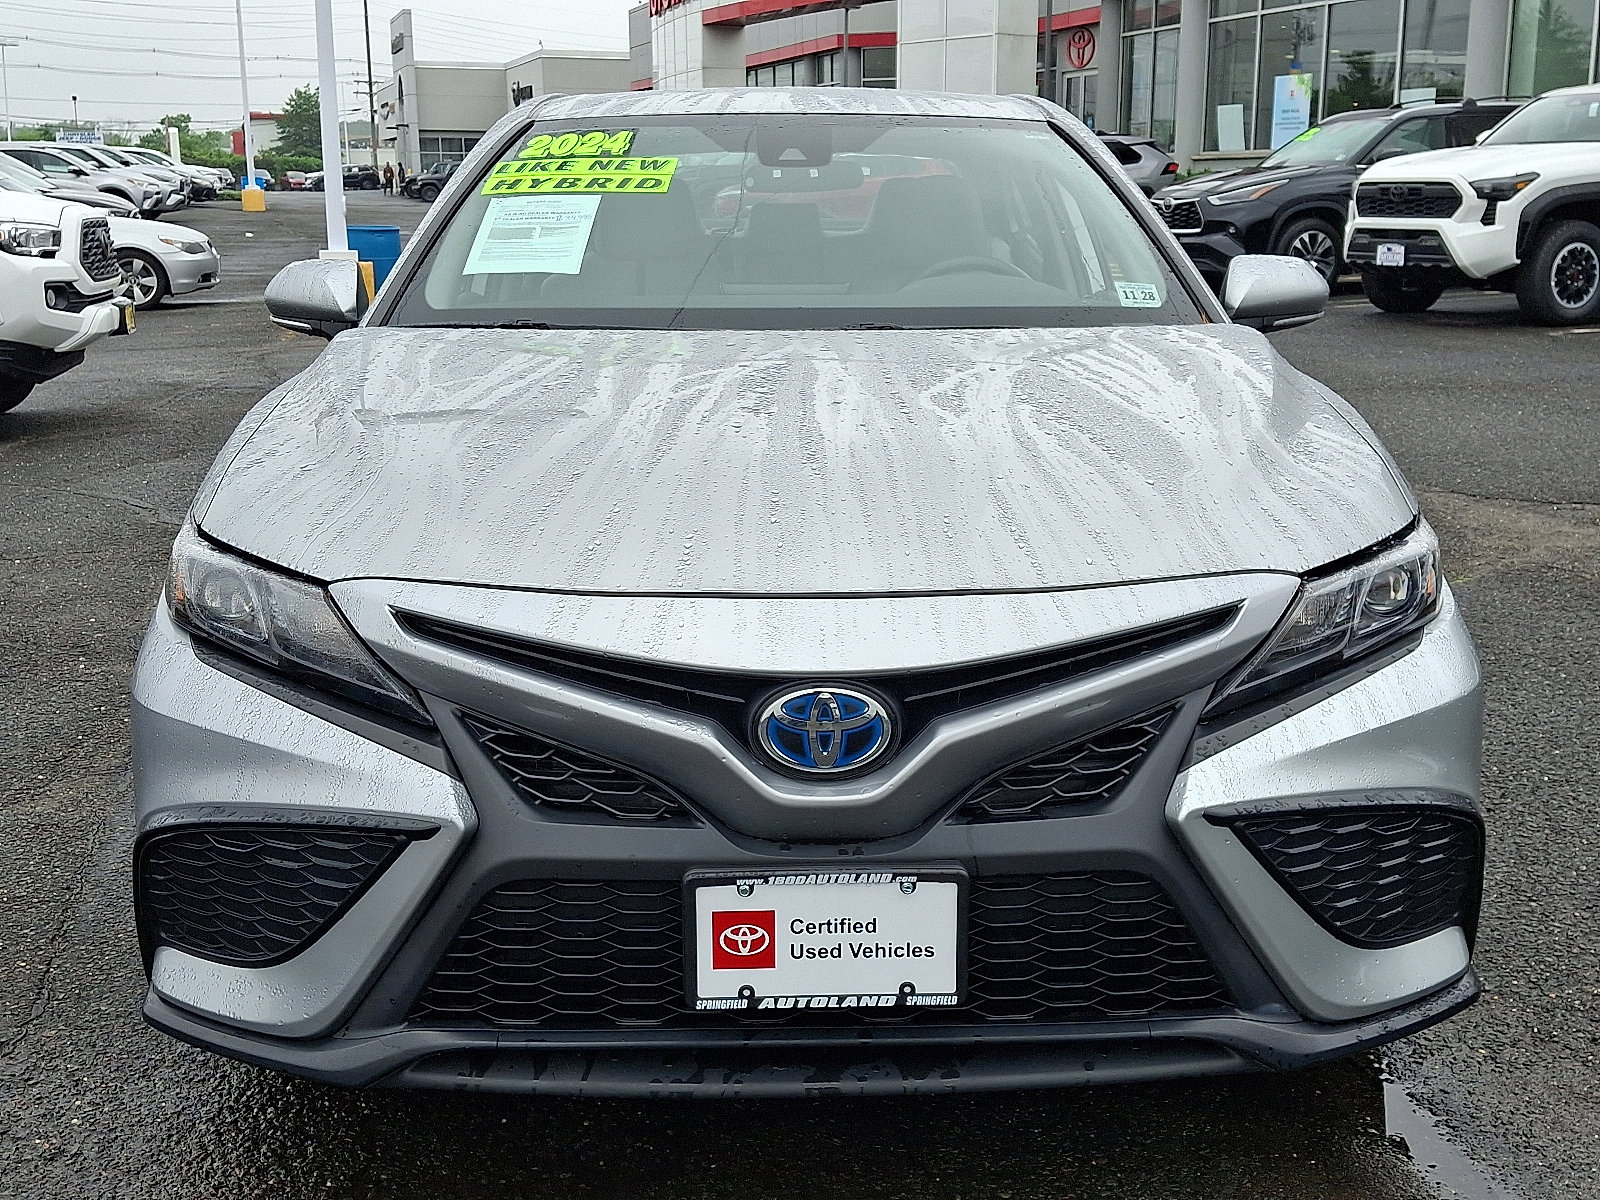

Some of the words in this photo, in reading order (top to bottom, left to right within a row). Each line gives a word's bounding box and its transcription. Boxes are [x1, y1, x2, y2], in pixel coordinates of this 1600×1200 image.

[518, 130, 634, 158] 2024
[495, 160, 578, 174] LIKE
[588, 159, 669, 171] NEW
[490, 177, 664, 191] HYBRID
[1122, 289, 1138, 300] 11
[1140, 290, 1156, 301] 28
[736, 873, 918, 886] www.1800AUTOLAND.com
[789, 917, 878, 935] Certified
[790, 942, 842, 960] Used
[849, 942, 935, 959] Vehicles
[695, 999, 749, 1010] SPRINGFIELD
[757, 996, 897, 1010] AUTOLAND
[906, 995, 958, 1006] SPRINGFIELD
